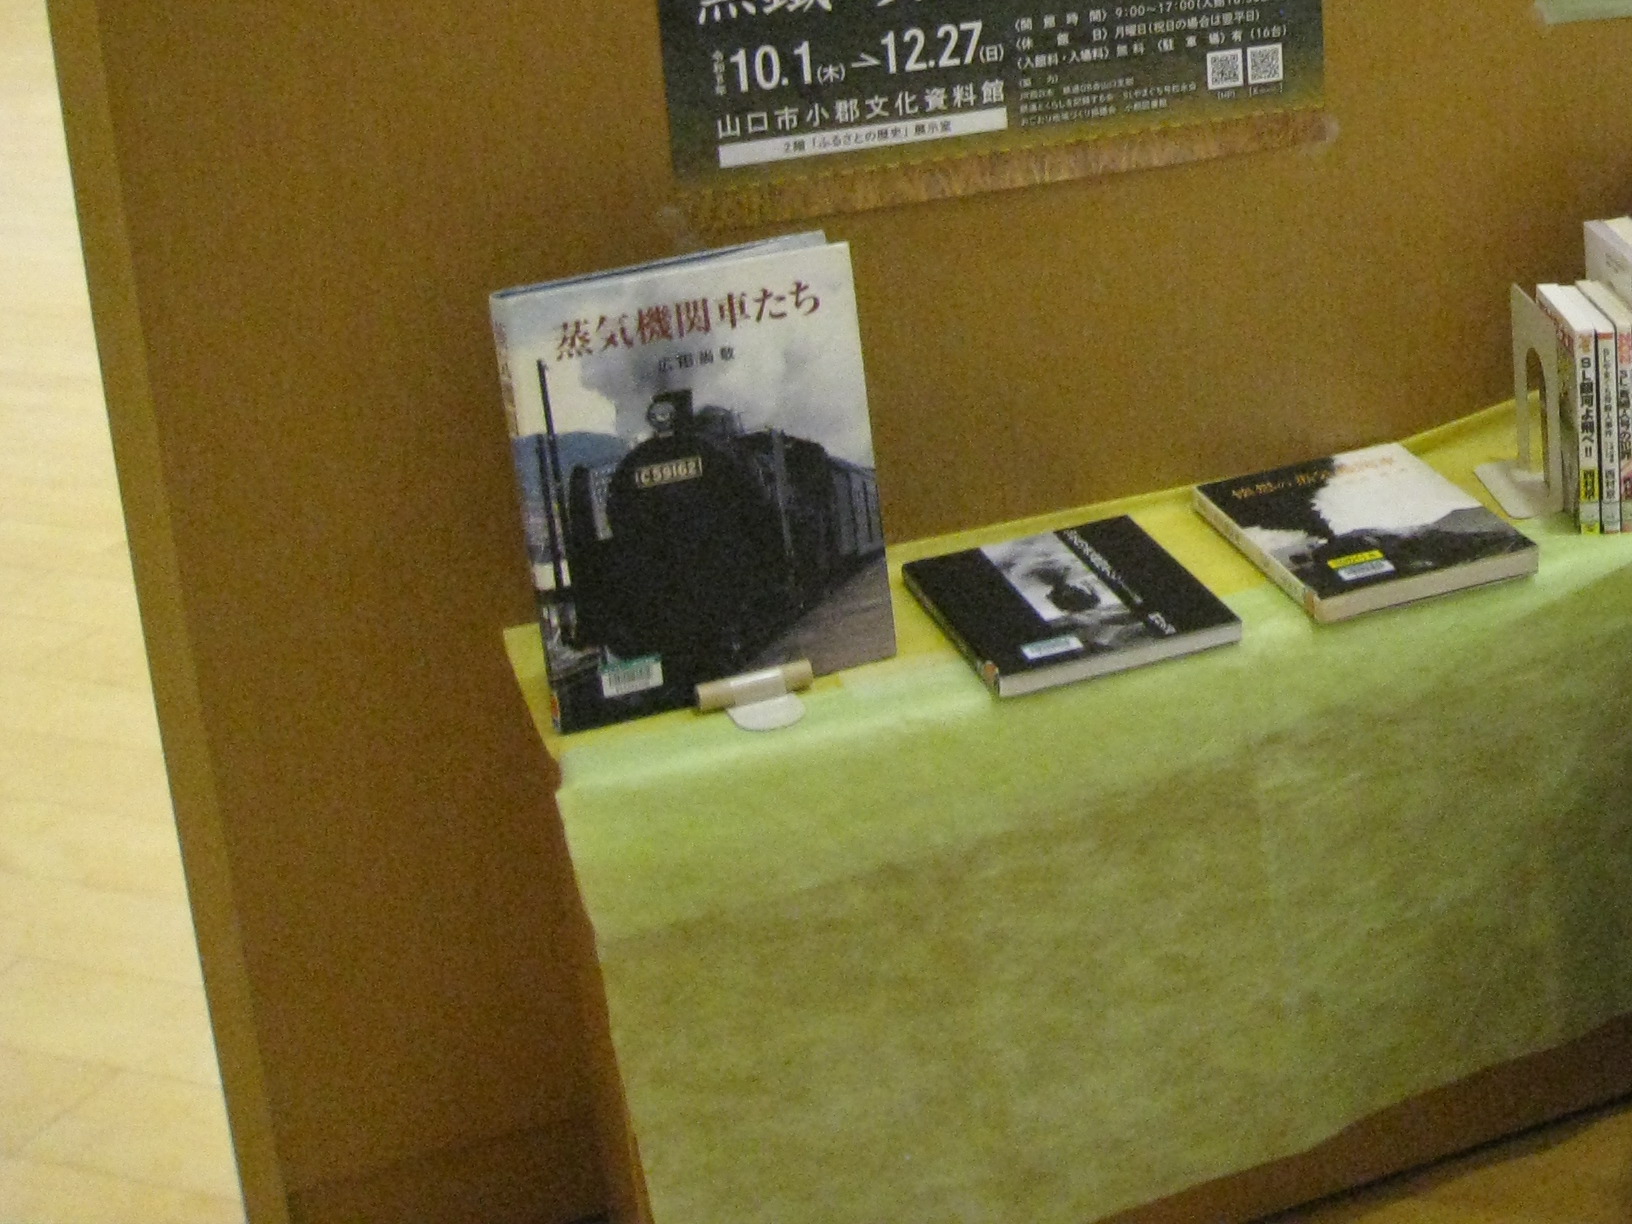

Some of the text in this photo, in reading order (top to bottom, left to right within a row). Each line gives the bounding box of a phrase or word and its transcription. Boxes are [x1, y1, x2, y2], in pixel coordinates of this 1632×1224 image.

[717, 79, 1005, 139] 山口市小郡文化資料館
[556, 280, 820, 361] 蒸気機関車たち
